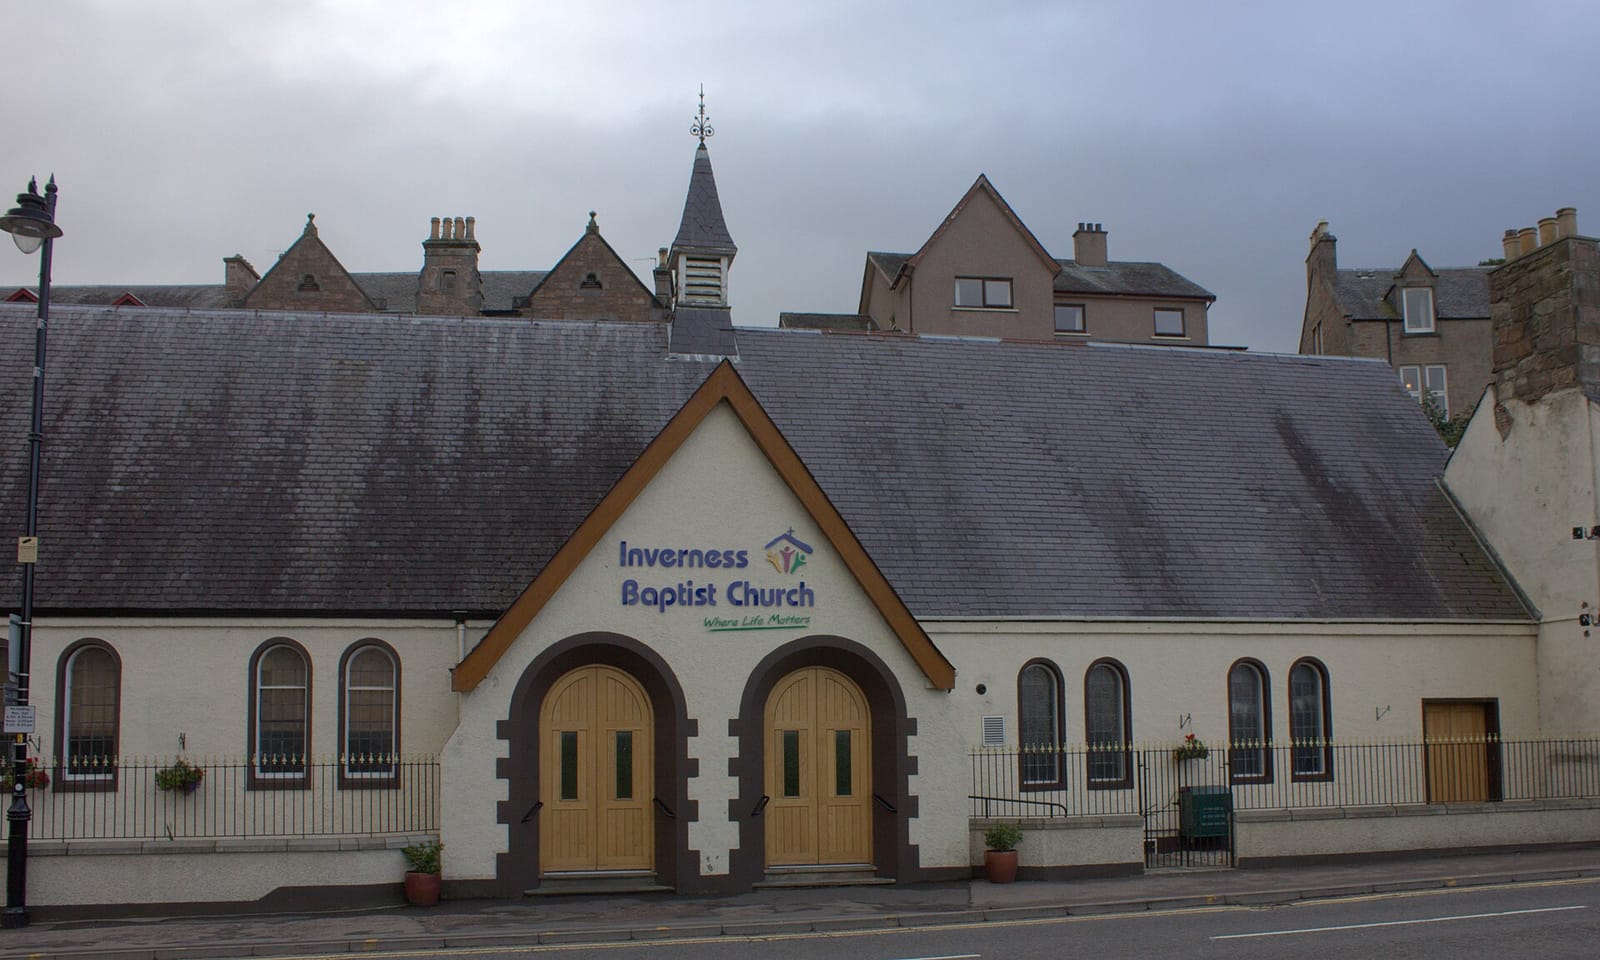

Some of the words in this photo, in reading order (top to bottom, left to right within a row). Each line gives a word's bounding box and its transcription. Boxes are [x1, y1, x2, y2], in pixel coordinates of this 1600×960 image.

[620, 541, 749, 568] Inverness
[622, 579, 717, 613] Baptist
[726, 581, 814, 607] Church
[704, 616, 739, 627] Where
[742, 615, 764, 626] Life
[768, 613, 811, 625] Matters
